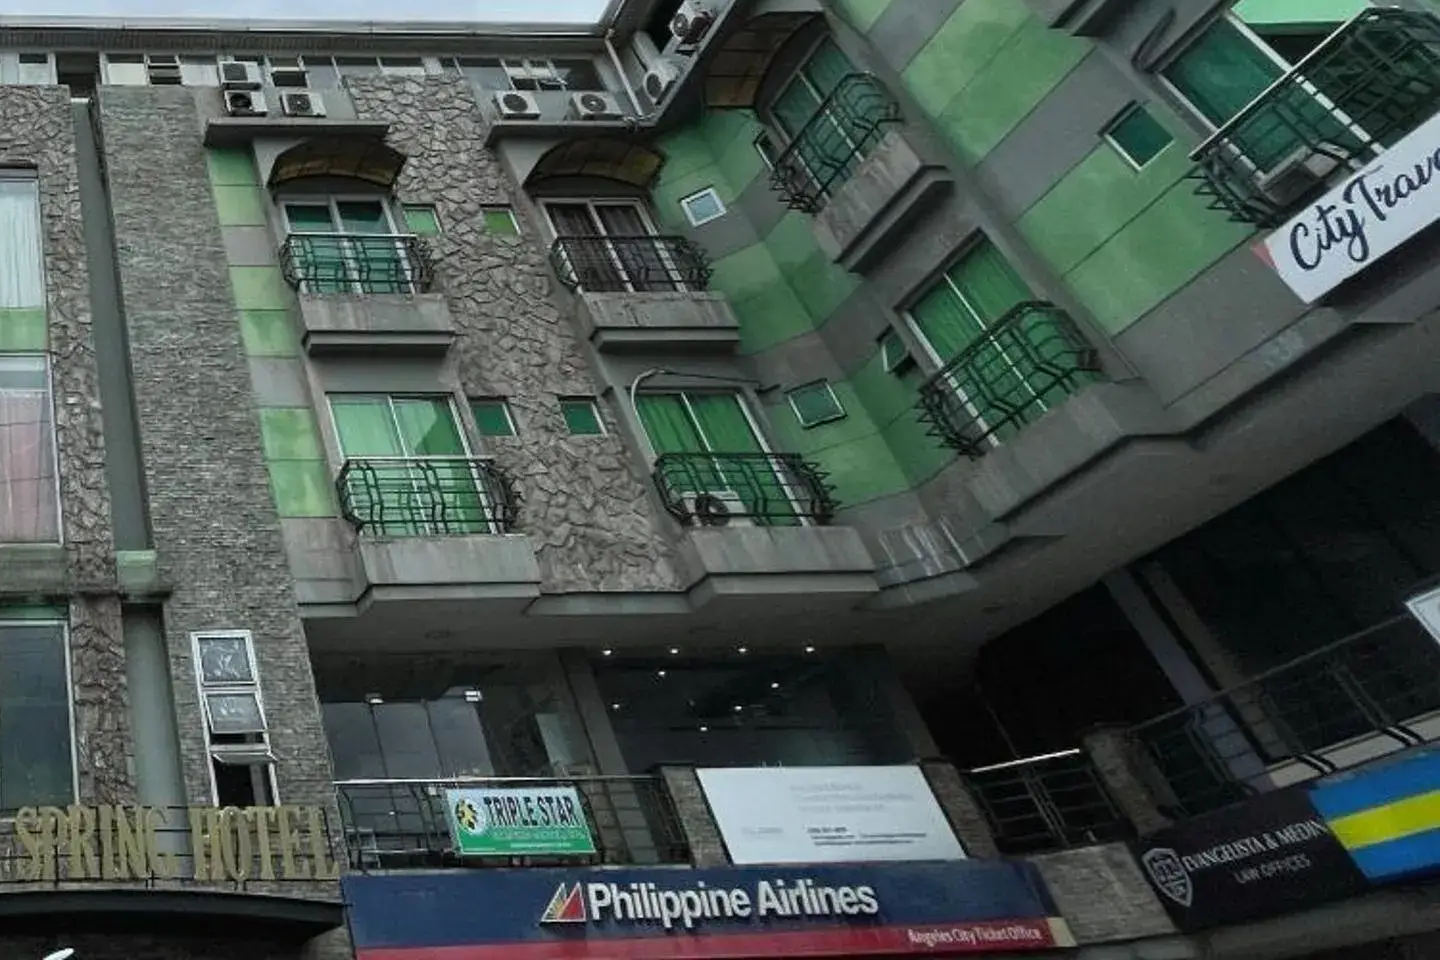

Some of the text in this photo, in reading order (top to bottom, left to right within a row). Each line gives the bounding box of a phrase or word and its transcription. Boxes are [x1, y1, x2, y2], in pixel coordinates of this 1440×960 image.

[1290, 205, 1369, 271] City
[483, 796, 581, 826] TRIPLE STAR
[14, 805, 179, 881] SPRING
[189, 805, 341, 881] HOTEL
[1181, 836, 1266, 872] EVANGELISTA
[1262, 833, 1279, 850] &
[1234, 853, 1311, 884] LAW OFFICES
[588, 879, 879, 928] Philippine Airlines
[952, 928, 976, 945] City
[1008, 925, 1042, 940] Office
